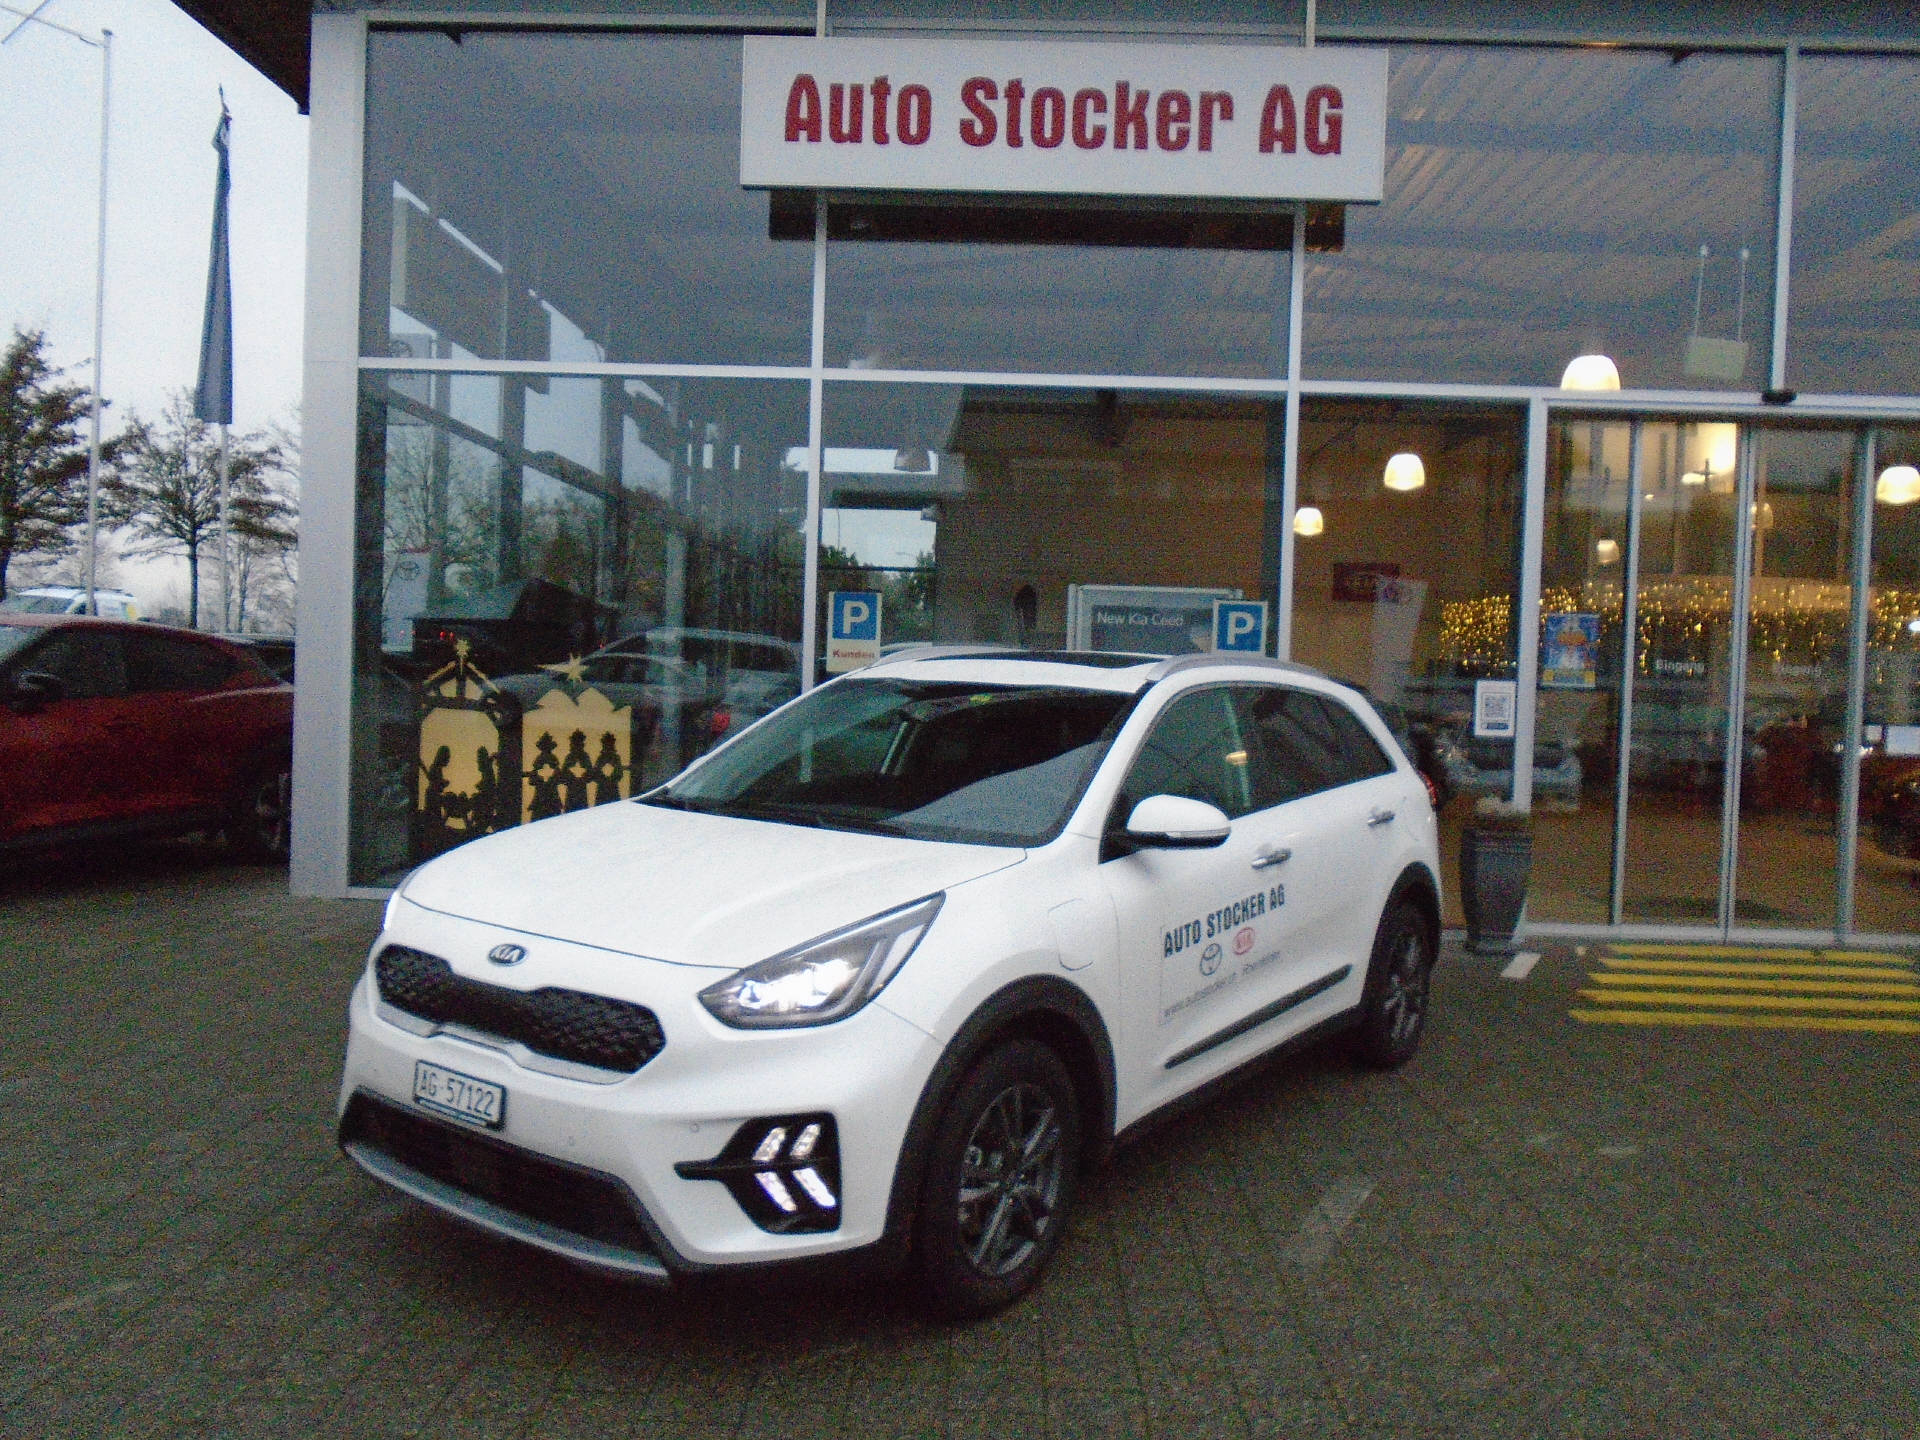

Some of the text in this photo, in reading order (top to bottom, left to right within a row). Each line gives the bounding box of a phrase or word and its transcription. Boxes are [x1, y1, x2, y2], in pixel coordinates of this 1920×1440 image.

[784, 73, 1344, 155] Auto Stocker AG
[842, 600, 870, 634] P
[1226, 611, 1255, 645] P
[1164, 883, 1287, 958] AUTO STOCKER AG
[421, 1070, 495, 1117] AG 57122
